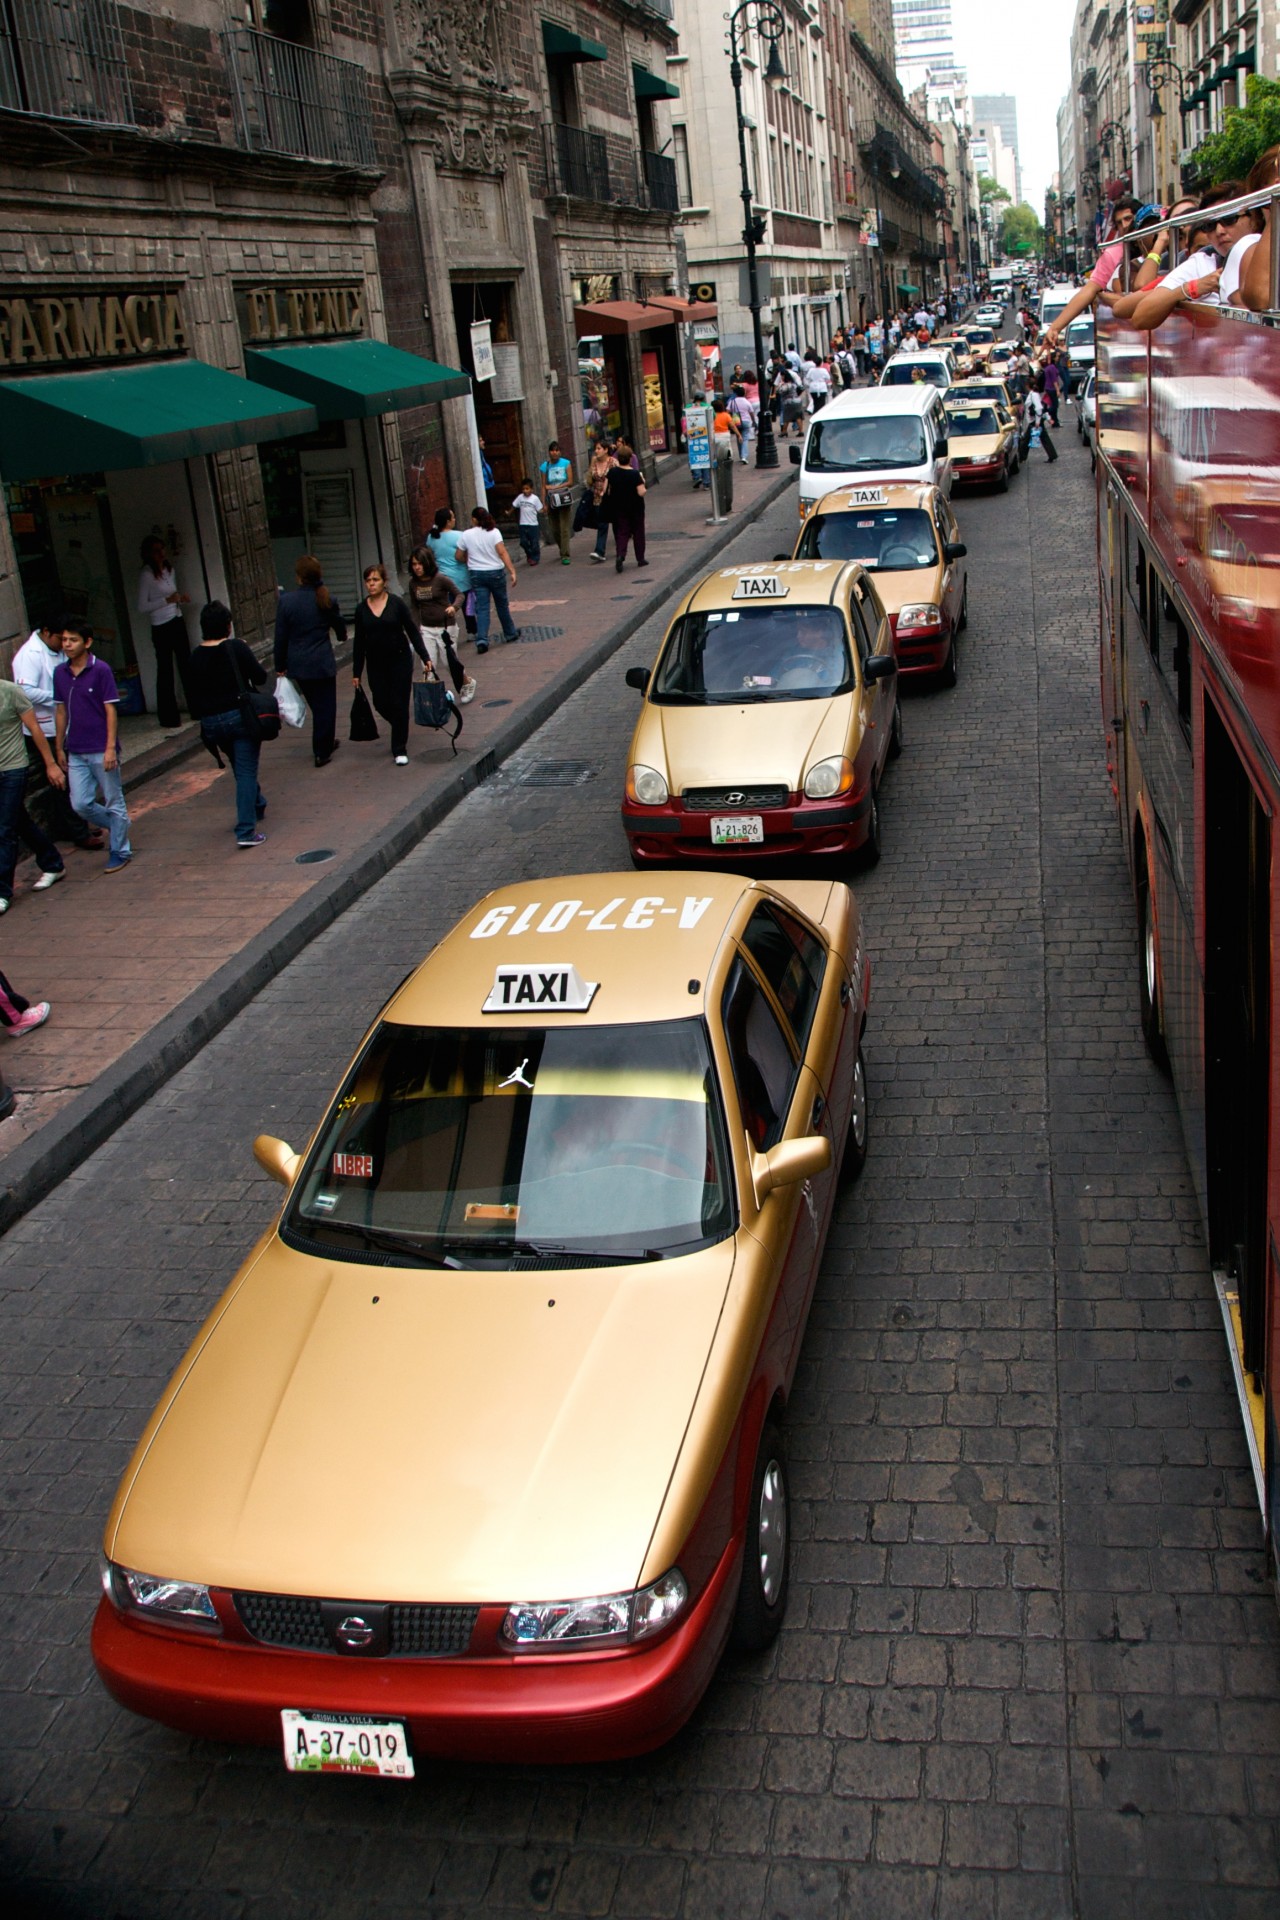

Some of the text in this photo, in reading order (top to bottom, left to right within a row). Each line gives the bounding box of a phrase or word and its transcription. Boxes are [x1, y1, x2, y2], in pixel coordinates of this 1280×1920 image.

[248, 287, 365, 339] EL FENIX
[0, 295, 187, 364] FARMACIA
[854, 490, 880, 502] TAXI
[720, 562, 832, 578] A-21-826
[740, 578, 776, 594] TAXI
[716, 824, 758, 836] A-21-826
[469, 896, 714, 939] A-37-019
[498, 972, 568, 1004] TAXI
[333, 1153, 372, 1177] LIBRE
[311, 1714, 374, 1725] GEISHA LA VILLA
[297, 1727, 398, 1758] A-37-019
[340, 1764, 361, 1772] TAXI
